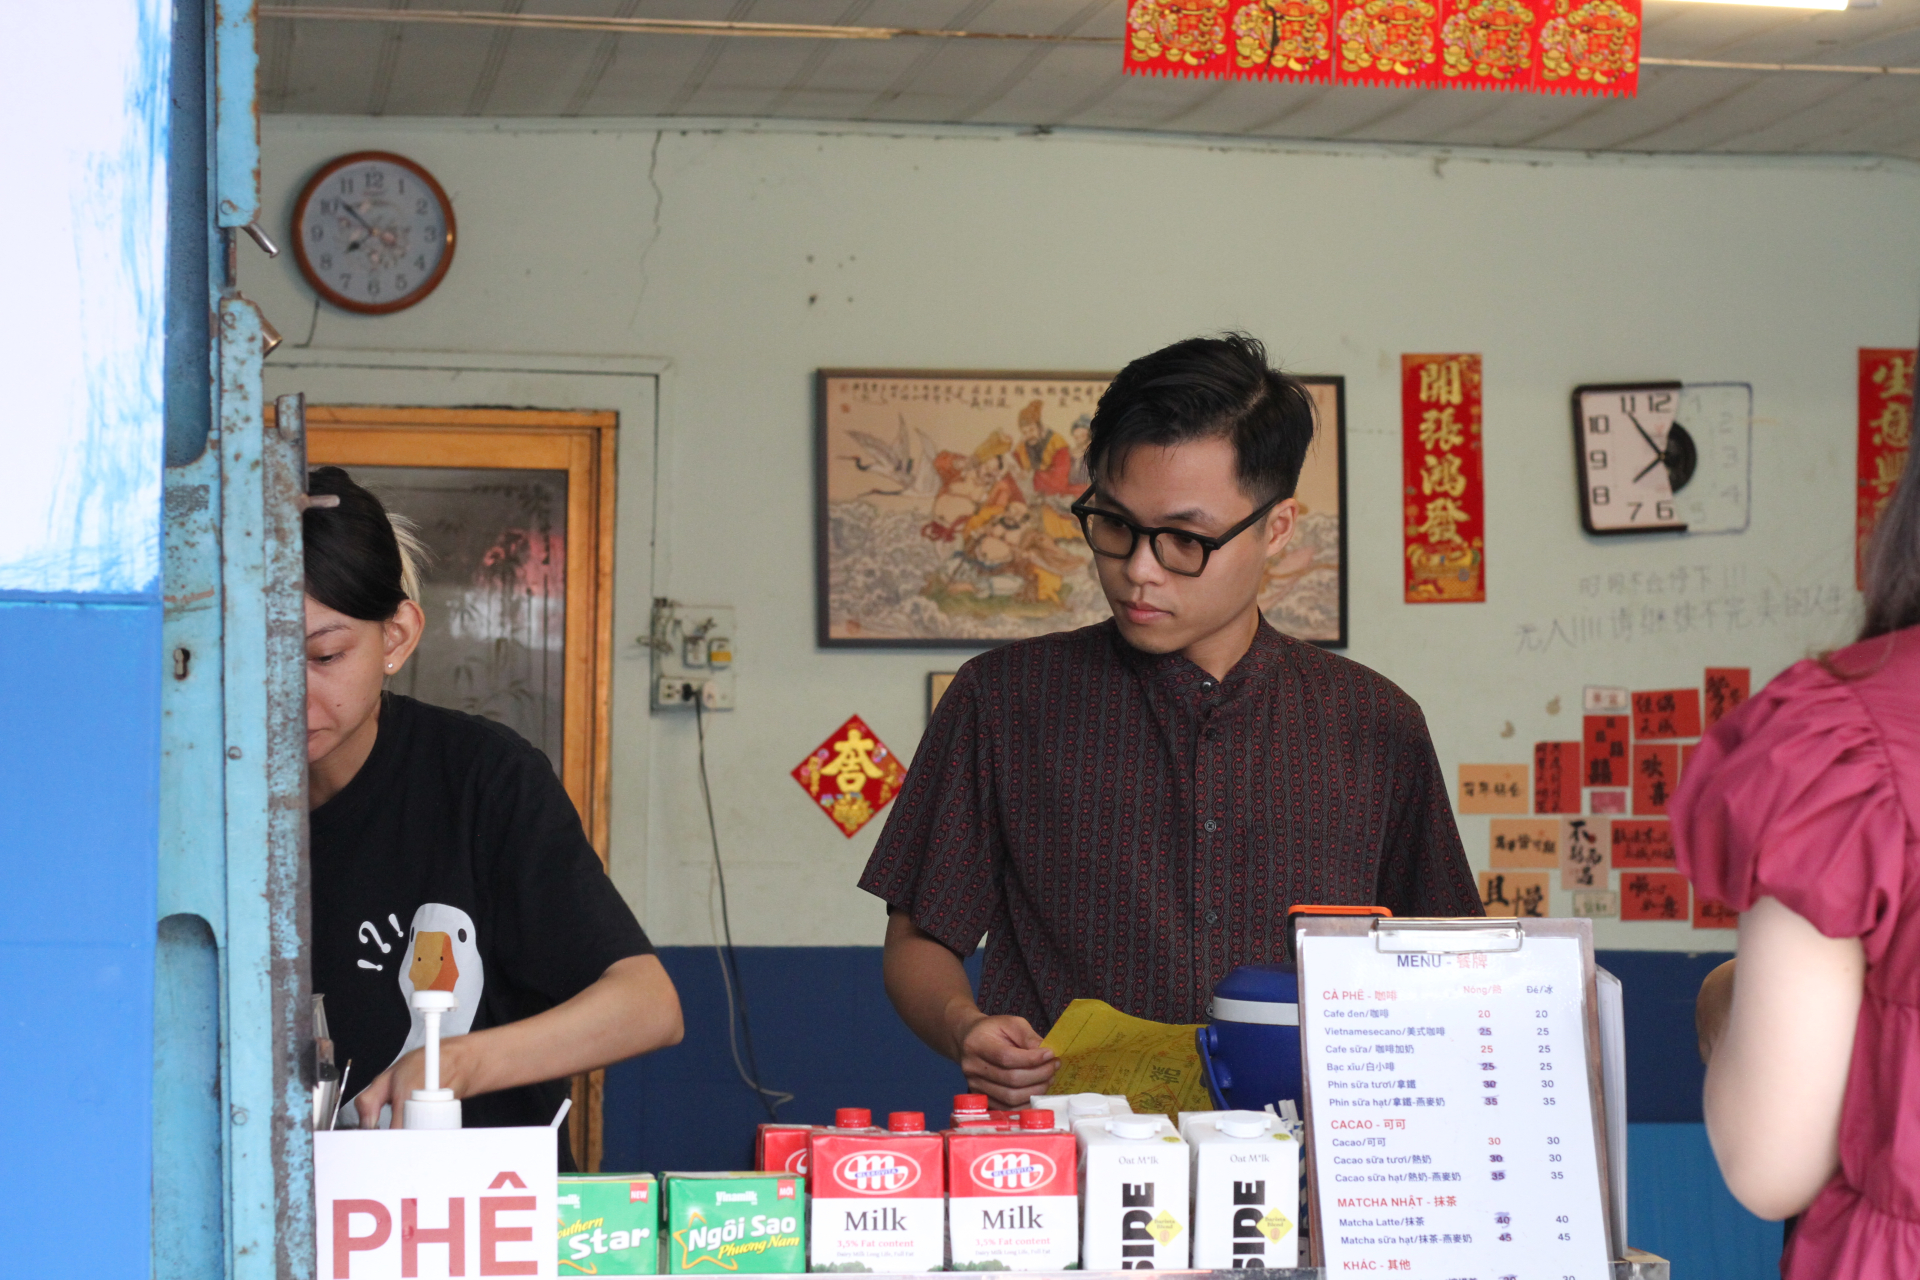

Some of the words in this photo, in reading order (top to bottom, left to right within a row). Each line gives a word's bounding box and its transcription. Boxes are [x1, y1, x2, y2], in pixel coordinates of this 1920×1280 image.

[364, 171, 384, 188] 12
[1620, 395, 1636, 414] 11
[1648, 394, 1672, 413] 12
[1589, 414, 1610, 435] 10
[1590, 450, 1608, 470] 9
[1592, 486, 1610, 505] 8
[1626, 501, 1643, 522] 7
[1655, 501, 1674, 520] 6
[1397, 954, 1441, 968] MENU
[1323, 988, 1339, 1001] CÀ
[1342, 989, 1365, 1001] PHÊ
[1323, 1009, 1345, 1018] Cafe
[1478, 1010, 1491, 1019] 20
[1535, 1010, 1548, 1019] 20
[1536, 1027, 1550, 1036] 25
[1325, 1045, 1347, 1054] Cafe
[1480, 1045, 1494, 1054] 25
[1538, 1045, 1551, 1054] 25
[1326, 1062, 1345, 1073] Bạc
[1539, 1062, 1553, 1071] 25
[1328, 1080, 1348, 1089] Phin
[1541, 1080, 1554, 1088] 30
[1329, 1098, 1350, 1107] Phin
[1484, 1097, 1498, 1106] 35
[1543, 1097, 1556, 1106] 35
[1330, 1119, 1373, 1130] CACAO
[1383, 1118, 1406, 1130] 可可
[1332, 1137, 1386, 1147] Cacao/可可
[1488, 1137, 1501, 1146] 30
[1547, 1136, 1560, 1145] 30
[1118, 1156, 1135, 1165] Oat
[1230, 1154, 1246, 1163] Oat
[1333, 1155, 1363, 1165] Cacao
[1549, 1154, 1562, 1163] 30
[1335, 1173, 1365, 1183] Cacao
[1551, 1171, 1564, 1180] 35
[630, 1190, 648, 1200] NEW
[1337, 1197, 1388, 1208] MATCHA
[1434, 1195, 1458, 1207] 抹茶
[844, 1207, 908, 1231] Milk
[982, 1205, 1044, 1230] Milk
[1555, 1215, 1569, 1224] 40
[332, 1170, 538, 1280] PHÊ
[1339, 1218, 1374, 1227] Matcha
[688, 1217, 745, 1252] Ngôi
[750, 1214, 797, 1238] Sao
[1558, 1233, 1571, 1241] 45
[568, 1227, 651, 1261] Star
[767, 1235, 800, 1250] Nam
[861, 1240, 876, 1248] Fat
[878, 1240, 914, 1248] content
[998, 1238, 1013, 1246] Fat
[1015, 1237, 1051, 1246] content
[1341, 1236, 1376, 1245] Matcha
[1343, 1258, 1377, 1270] KHÁC
[1387, 1259, 1412, 1270] 其他
